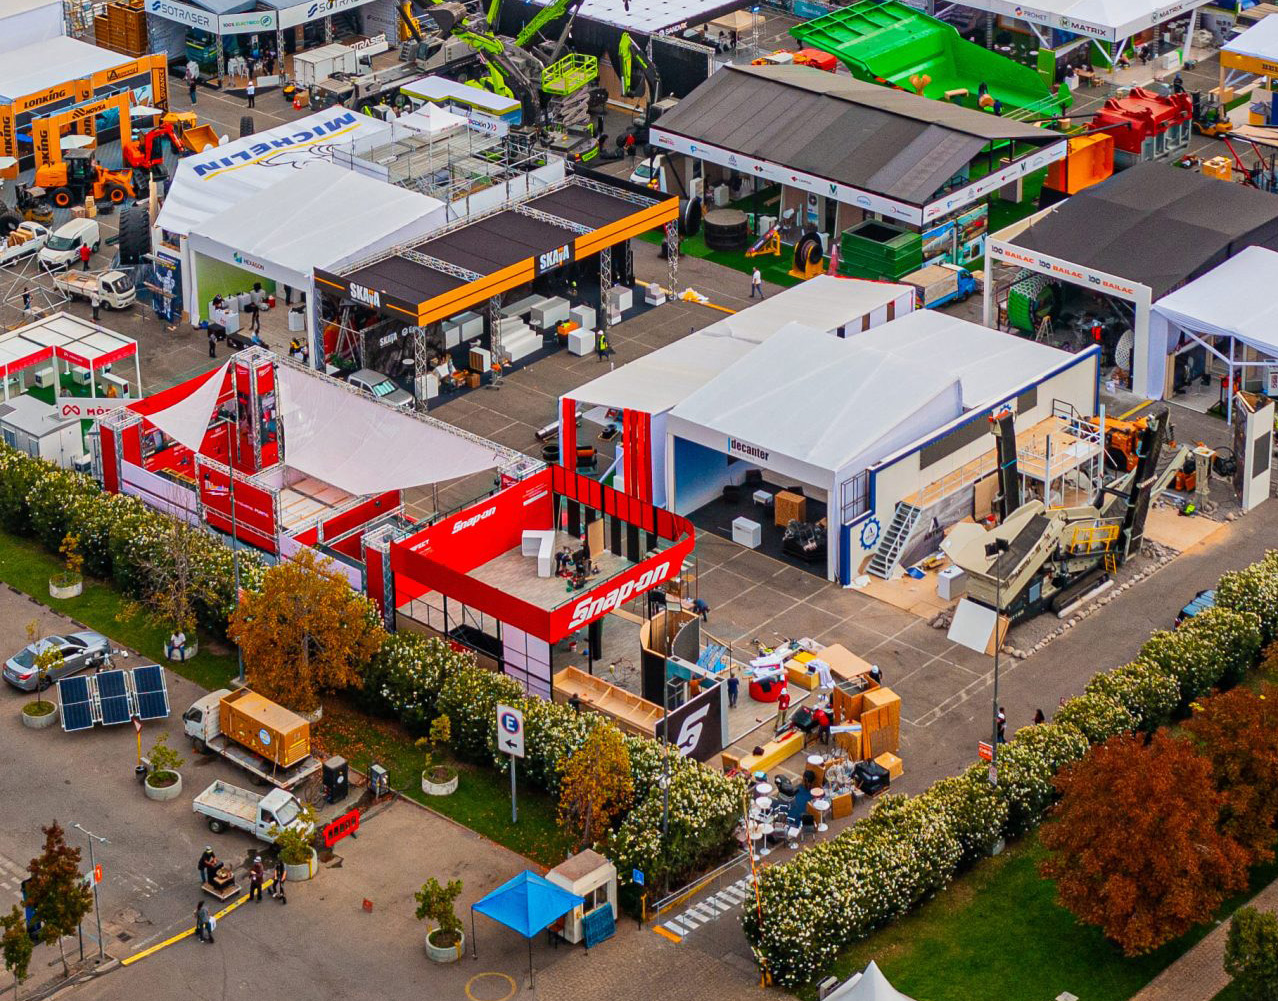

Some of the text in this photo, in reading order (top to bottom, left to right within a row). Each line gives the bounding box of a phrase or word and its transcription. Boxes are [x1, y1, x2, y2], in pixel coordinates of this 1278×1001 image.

[161, 2, 210, 27] SOTRASER
[1159, 3, 1183, 20] MATRIX
[1070, 21, 1106, 37] MATRIX
[193, 112, 357, 177] MICHELIN
[991, 245, 1003, 255] 100
[1038, 259, 1051, 270] 100
[1088, 274, 1101, 285] 100
[731, 438, 769, 461] decanter
[451, 506, 497, 535] Snap-on
[568, 561, 670, 630] Snap-on
[505, 715, 516, 732] E
